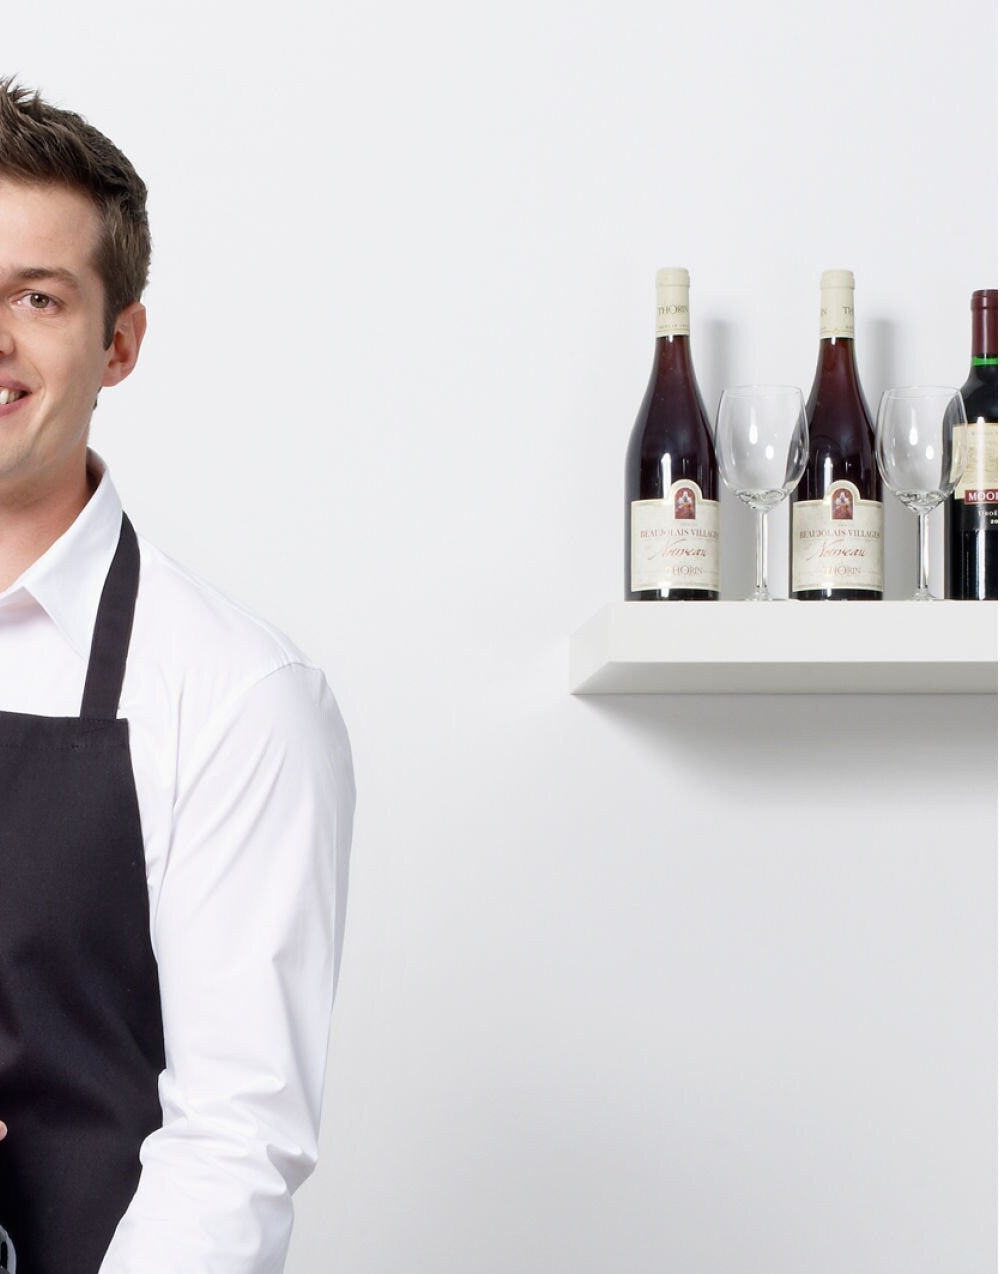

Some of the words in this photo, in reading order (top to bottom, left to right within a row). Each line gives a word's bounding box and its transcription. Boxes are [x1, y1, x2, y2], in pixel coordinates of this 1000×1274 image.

[967, 491, 998, 502] MOO
[640, 528, 689, 538] BEAUJOLAIS
[799, 528, 846, 539] BEAUJOLAIS
